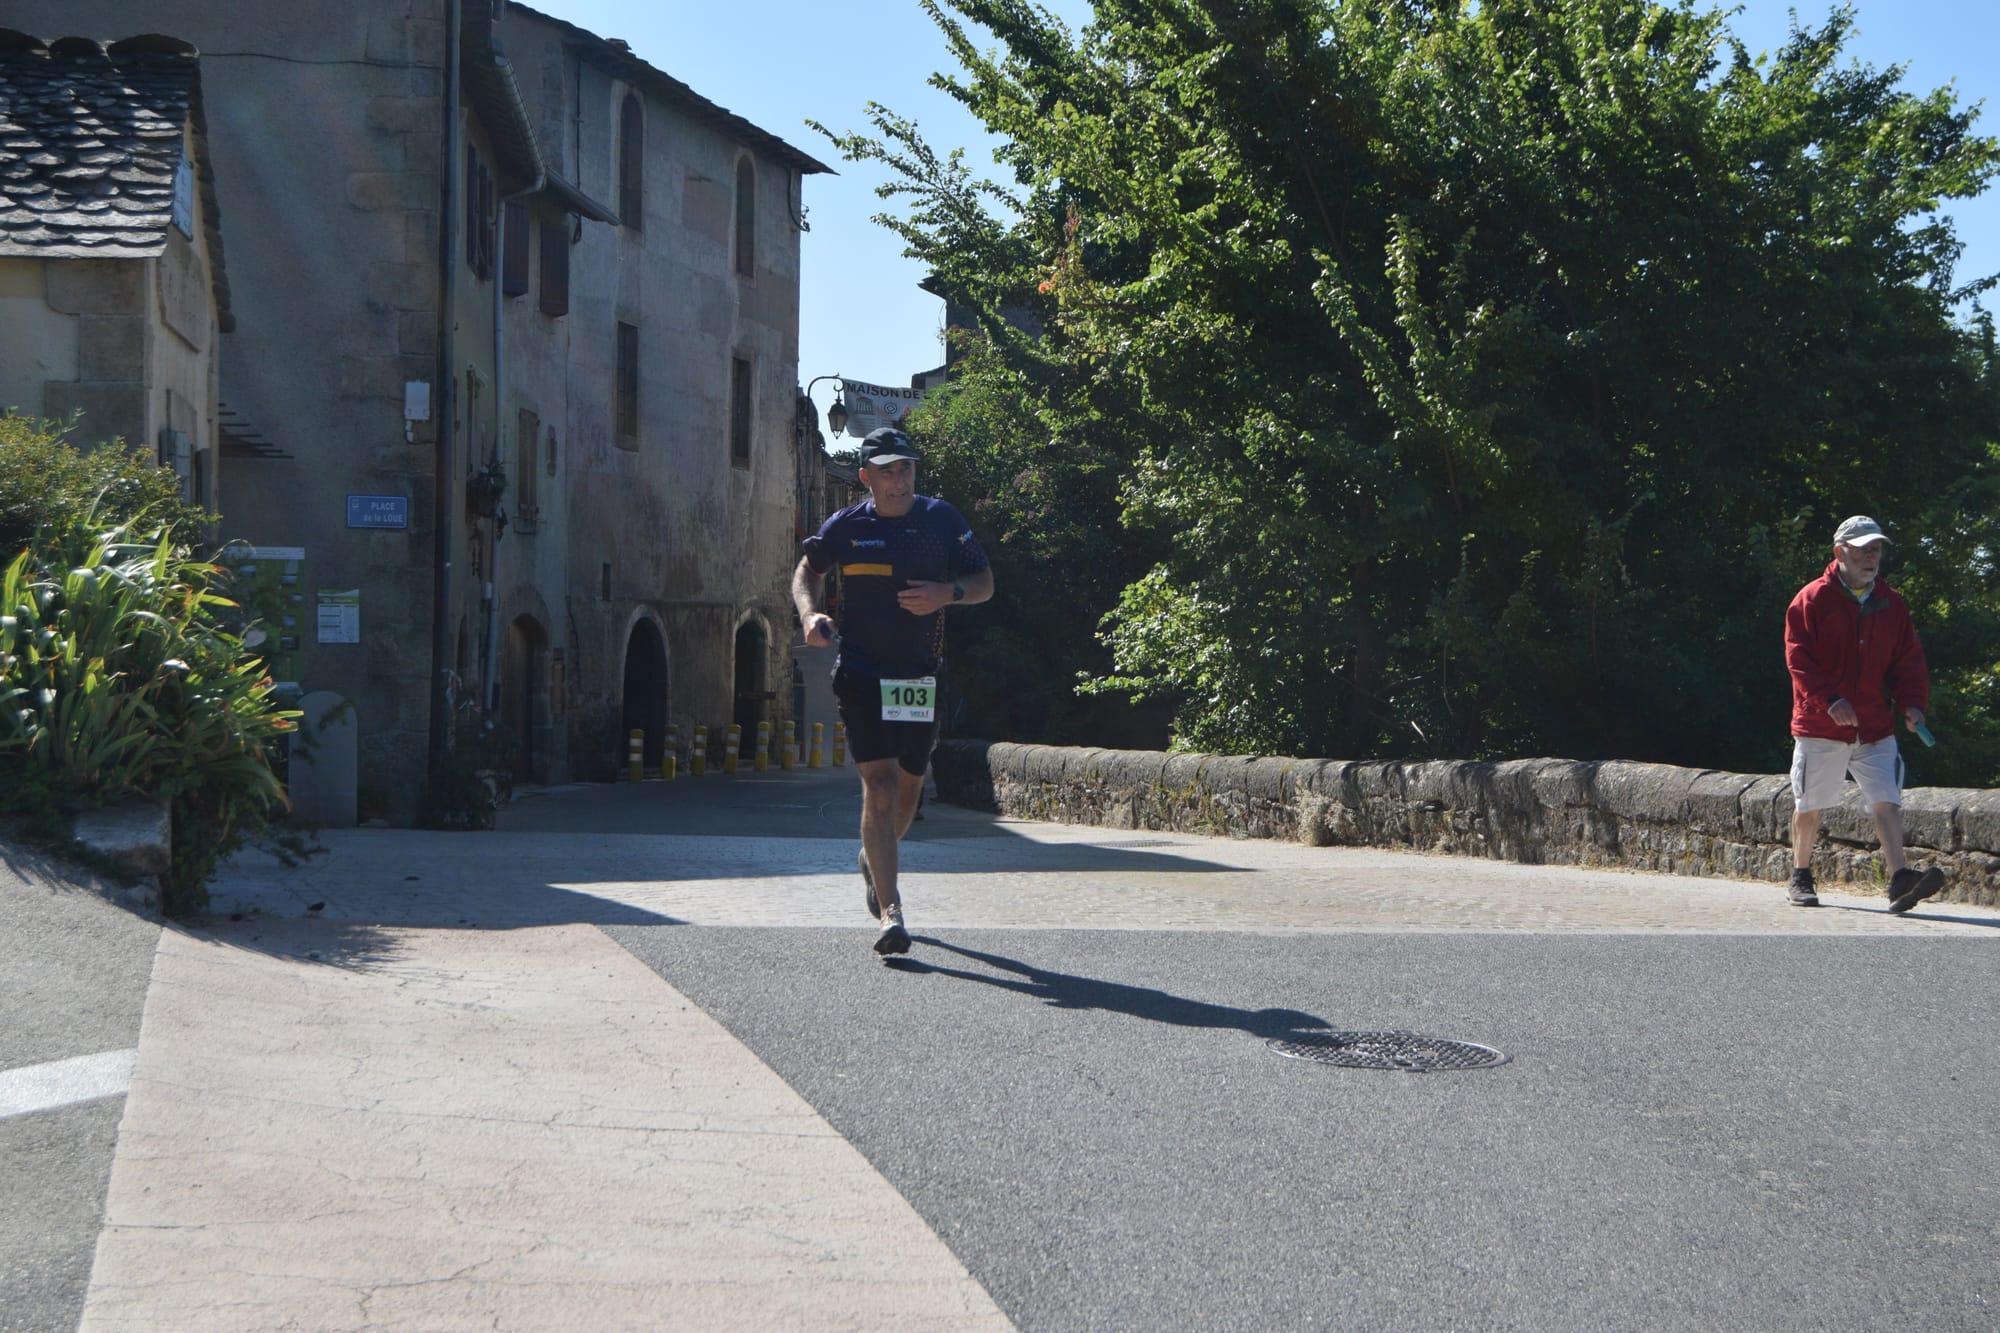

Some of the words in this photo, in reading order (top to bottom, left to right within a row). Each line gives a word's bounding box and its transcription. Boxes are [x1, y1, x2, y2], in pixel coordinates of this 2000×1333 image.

[847, 383, 899, 398] MAISON
[903, 390, 920, 399] DE
[371, 502, 396, 511] PLACE
[384, 514, 404, 522] LOUE
[890, 687, 928, 706] 103
